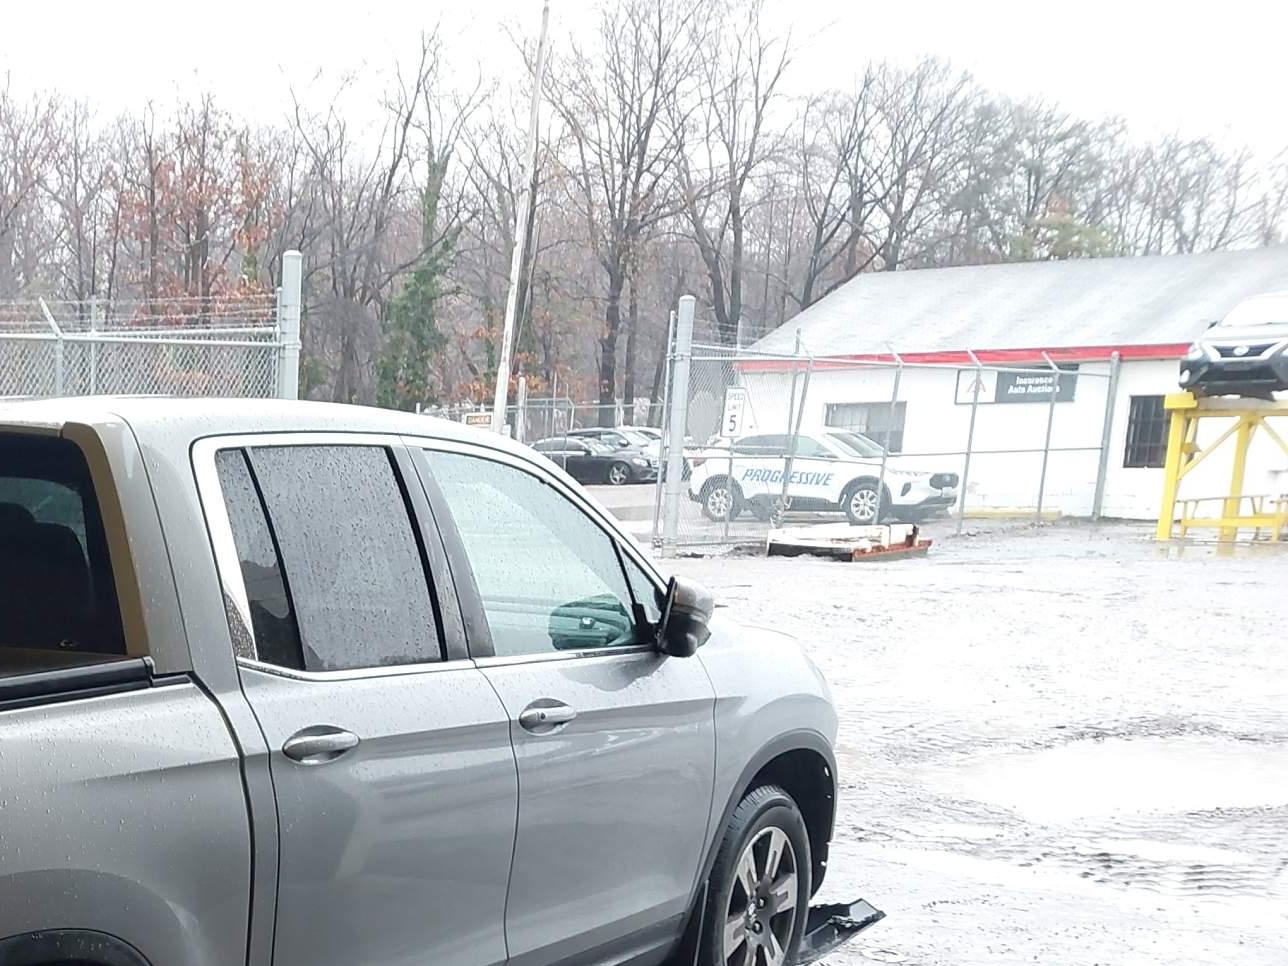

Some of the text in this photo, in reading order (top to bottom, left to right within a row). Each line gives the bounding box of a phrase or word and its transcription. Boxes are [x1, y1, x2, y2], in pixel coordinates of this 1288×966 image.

[1007, 384, 1061, 394] Auto Auctios
[727, 392, 745, 401] SPEED
[728, 414, 737, 432] 5
